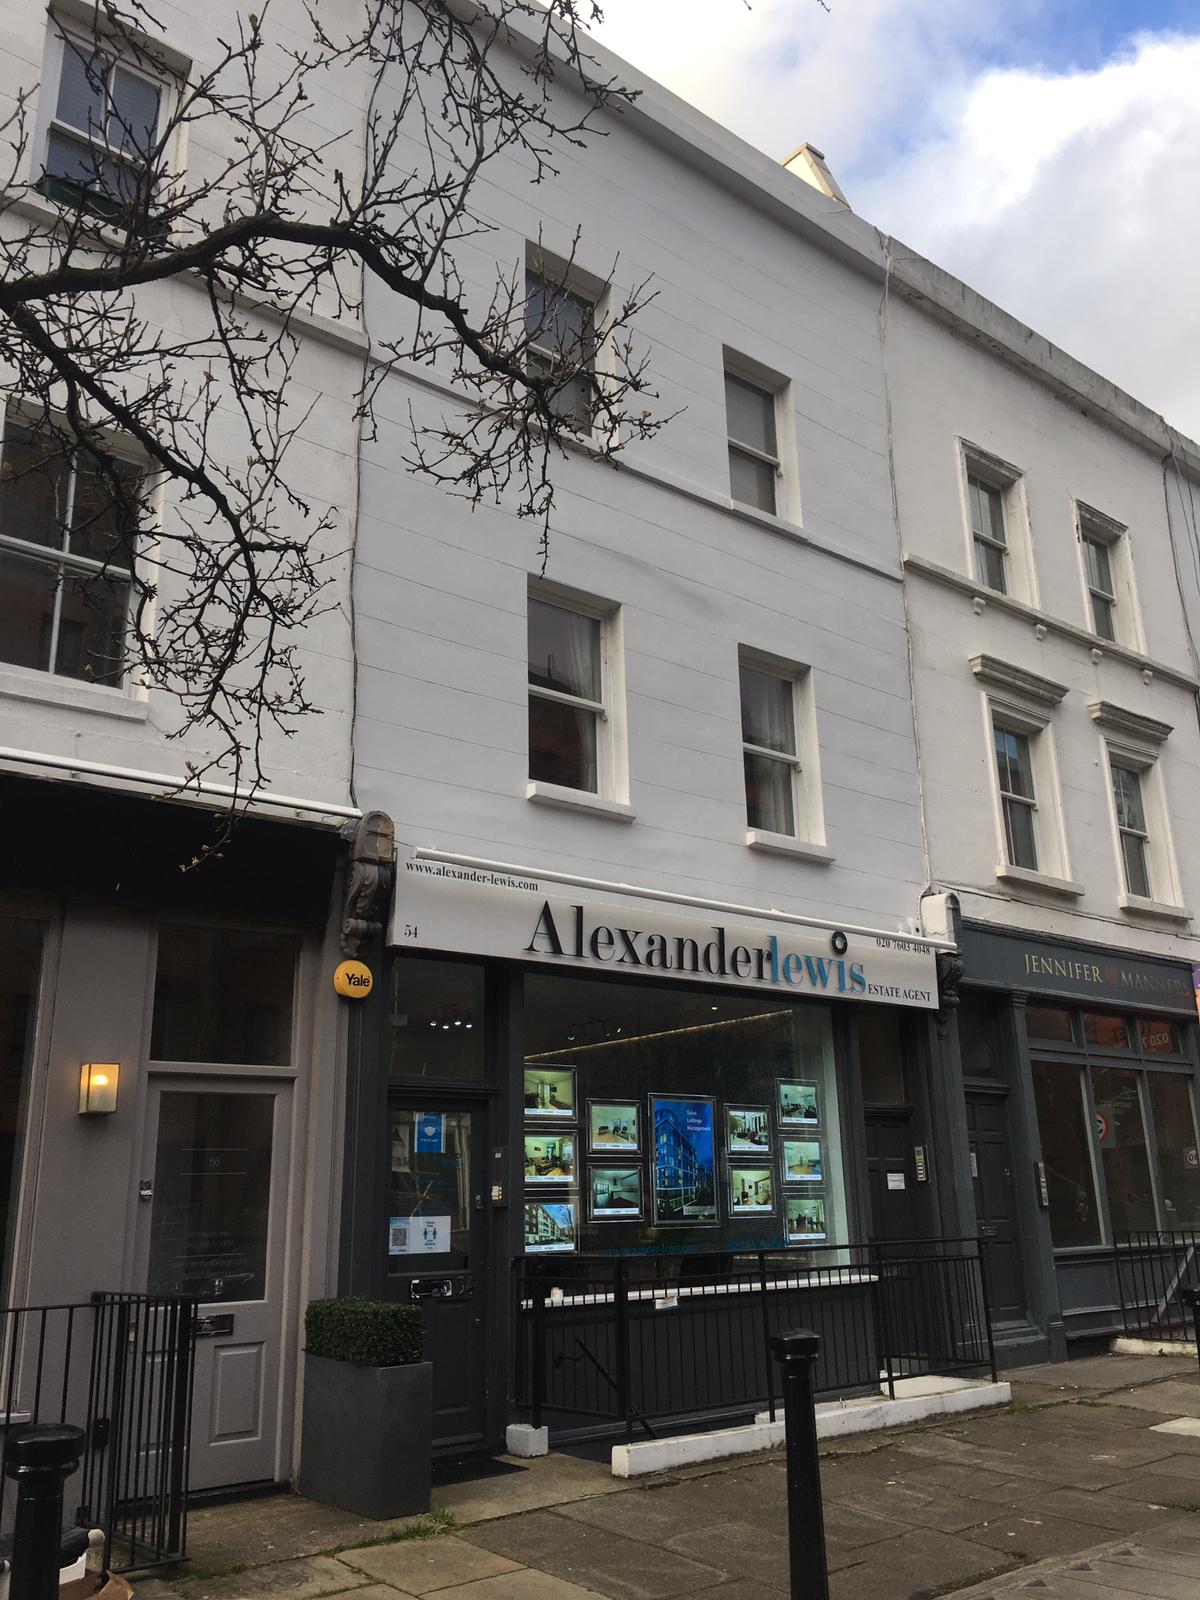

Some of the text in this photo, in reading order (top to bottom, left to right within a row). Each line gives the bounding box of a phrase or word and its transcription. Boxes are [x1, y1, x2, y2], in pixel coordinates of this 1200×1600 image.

[405, 861, 539, 891] www.alexander-lewis.com
[403, 924, 419, 939] 54
[876, 937, 891, 949] 020
[912, 943, 931, 955] 4048
[1024, 954, 1104, 983] JENNIFER
[345, 972, 370, 987] Yale
[868, 984, 932, 1003] ESTATE AGENT
[207, 1156, 222, 1167] 56
